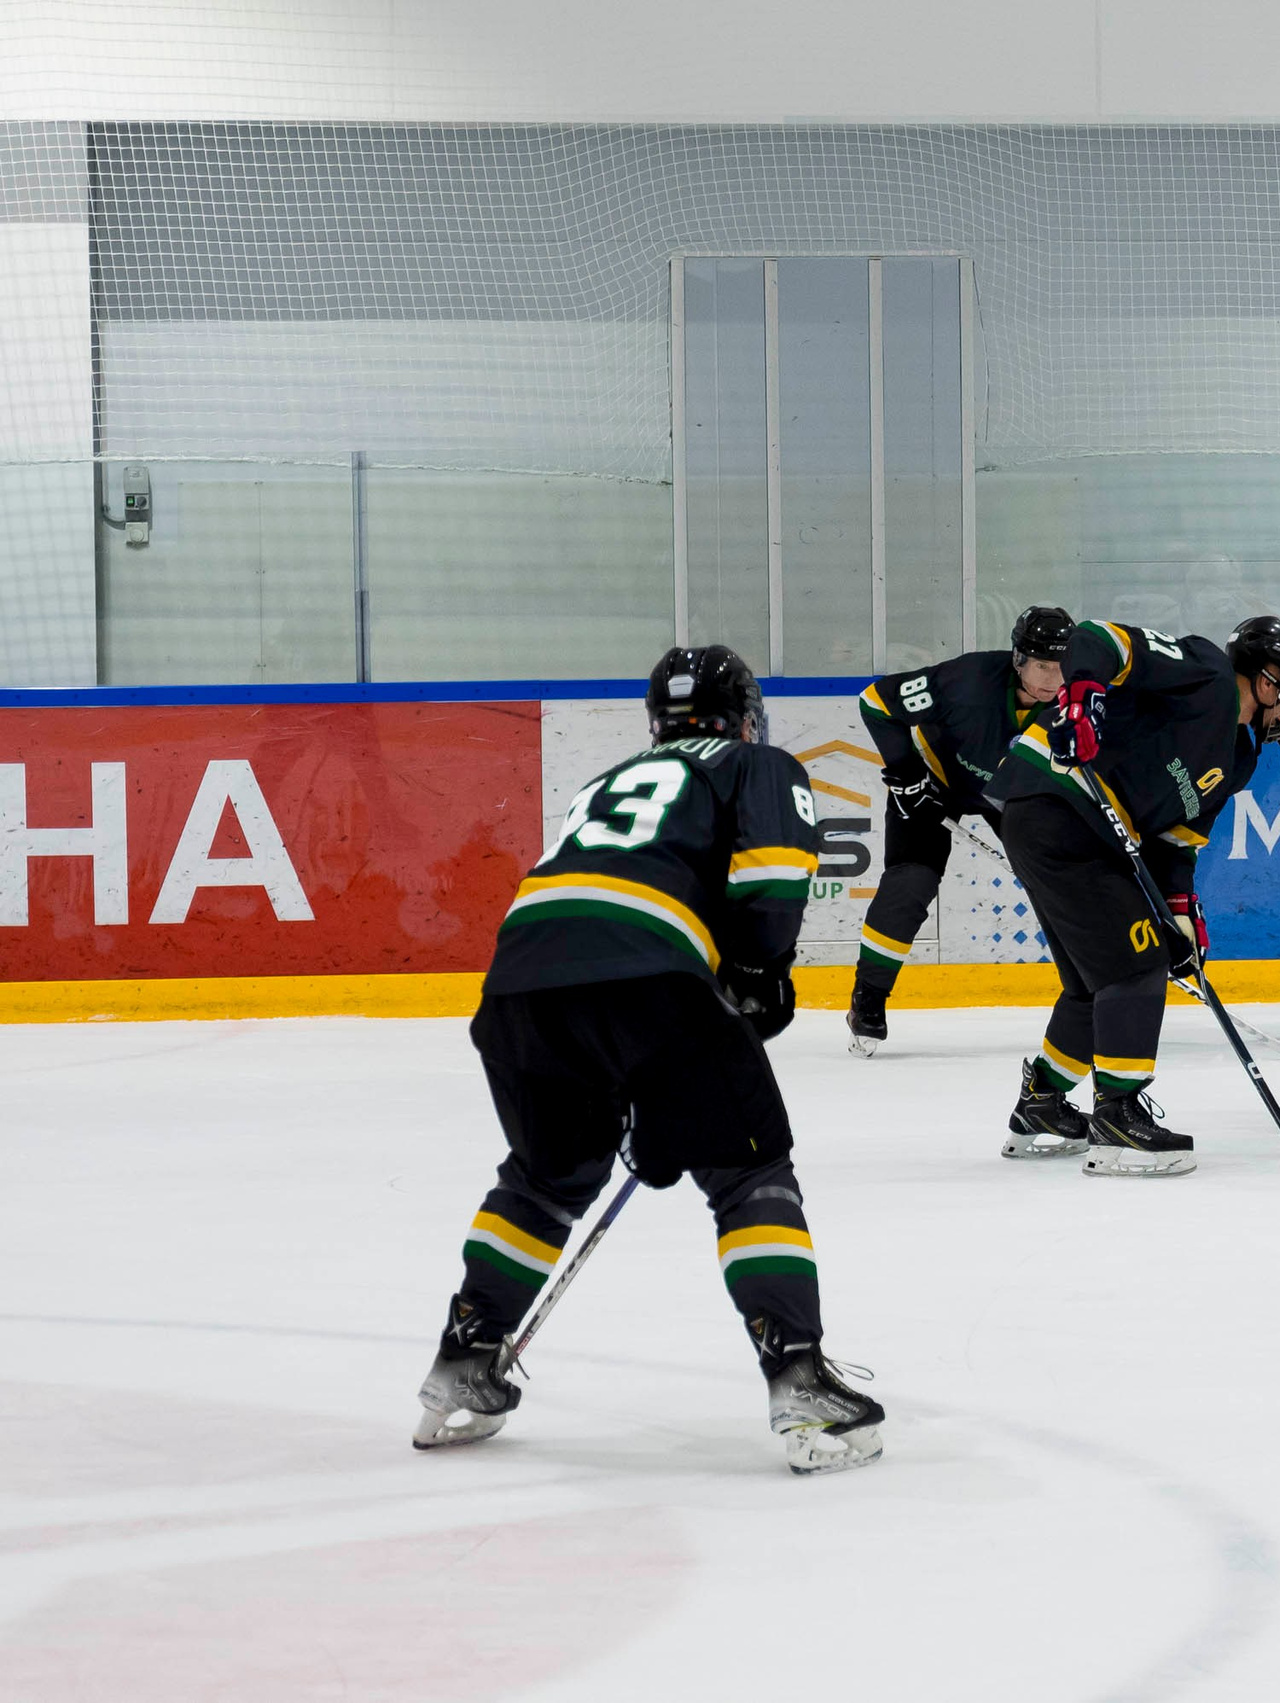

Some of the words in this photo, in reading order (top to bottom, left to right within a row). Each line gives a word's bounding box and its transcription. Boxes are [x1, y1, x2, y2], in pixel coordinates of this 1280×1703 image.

[1141, 627, 1183, 660] 27
[900, 675, 934, 713] 88
[1127, 1128, 1152, 1141] CCM
[828, 1394, 860, 1413] BAUER
